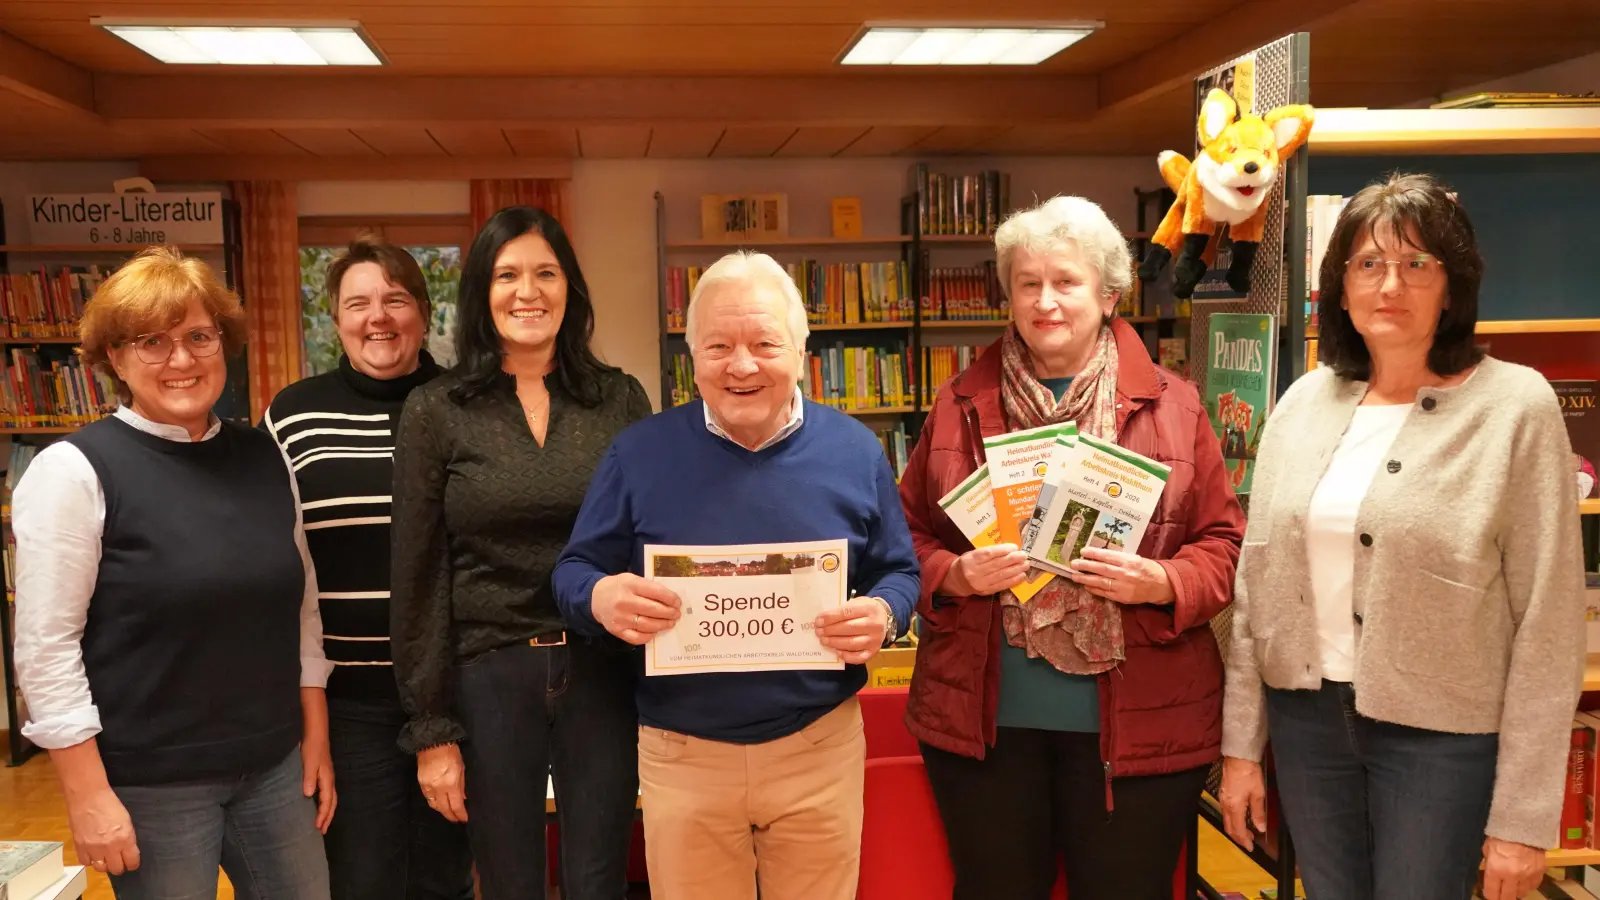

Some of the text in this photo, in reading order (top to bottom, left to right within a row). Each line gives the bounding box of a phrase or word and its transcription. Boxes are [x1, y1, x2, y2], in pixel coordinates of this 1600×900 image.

[32, 196, 216, 223] Kinder-Literatur
[89, 228, 98, 243] 6
[113, 228, 122, 243] 8
[126, 227, 166, 244] Jahre
[1568, 395, 1596, 408] XIV.
[1006, 440, 1056, 456] Heimatkundlic
[1000, 454, 1040, 467] Arbeitskreis
[1092, 451, 1150, 481] Heimatkundlicher
[1009, 471, 1019, 479] Heft
[1080, 459, 1119, 479] Arbeitskreis
[1083, 475, 1095, 485] Heft
[1124, 492, 1141, 503] 2026
[976, 514, 988, 526] Heft
[704, 592, 790, 615] Spende
[698, 618, 794, 639] 300,00 €
